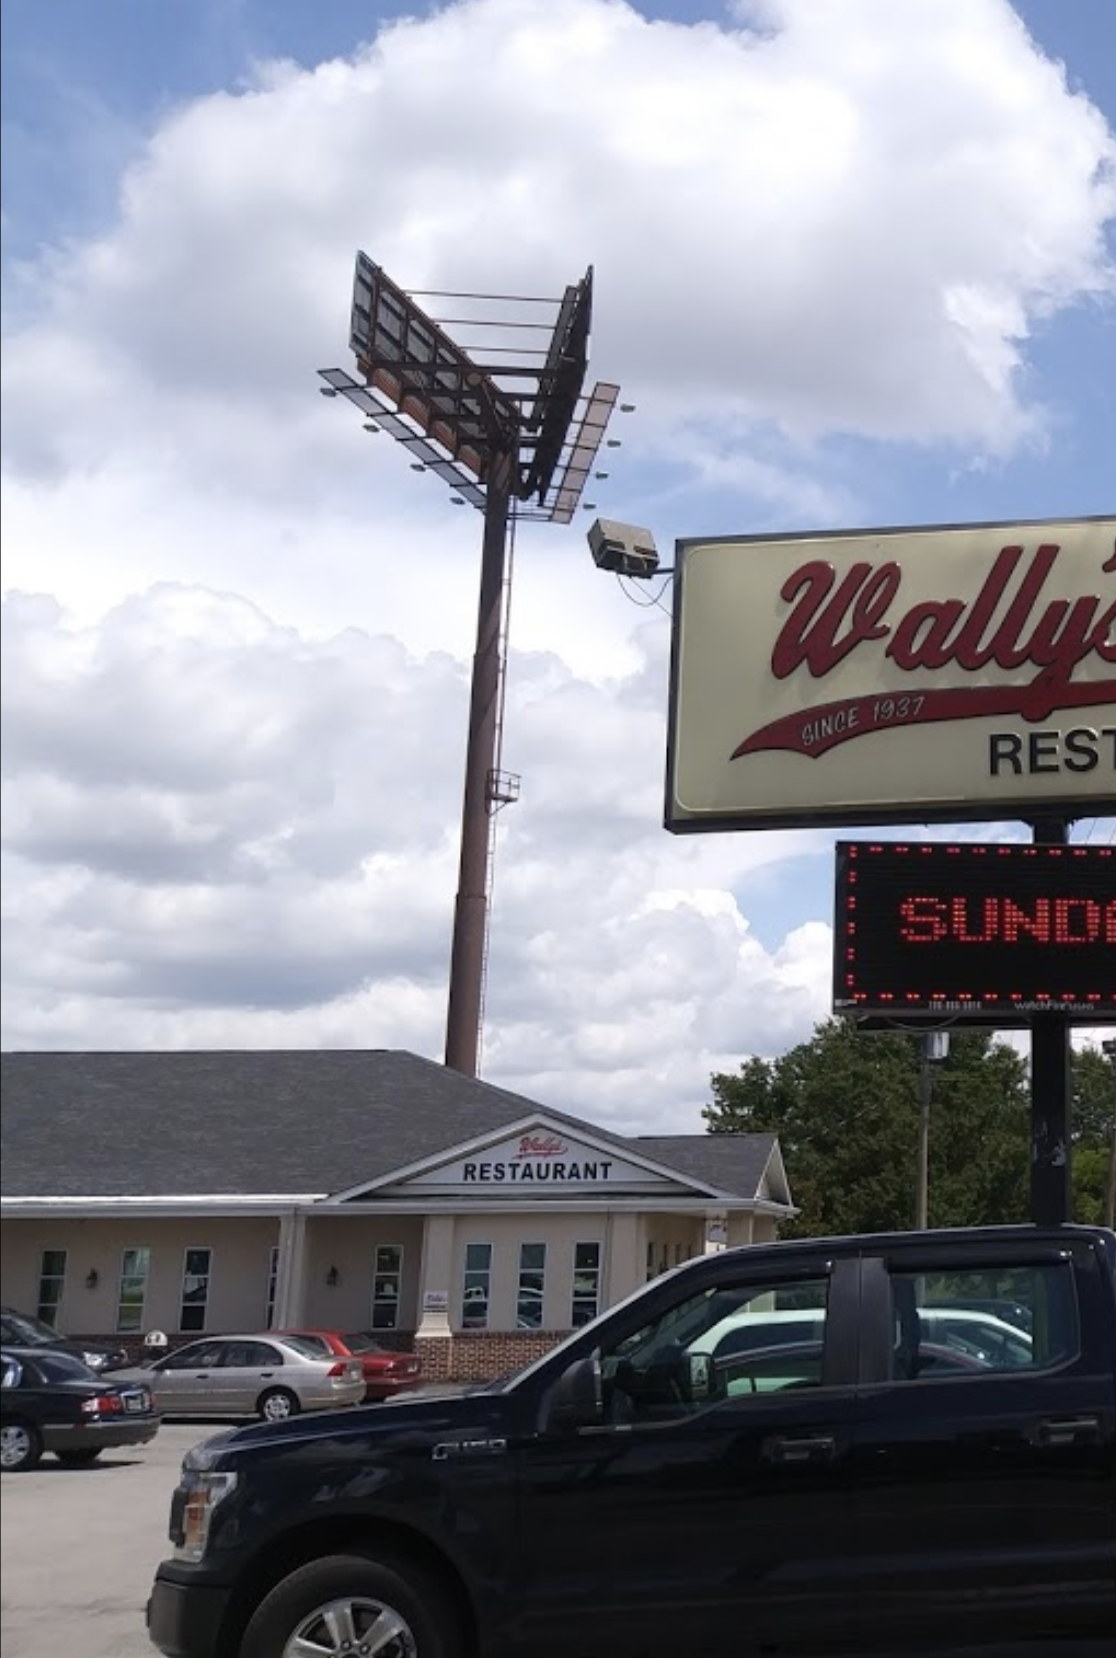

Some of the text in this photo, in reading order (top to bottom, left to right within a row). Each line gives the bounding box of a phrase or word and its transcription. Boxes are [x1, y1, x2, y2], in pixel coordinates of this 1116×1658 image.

[802, 696, 925, 746] SINCE 1937
[463, 1162, 613, 1181] RESTAURANT
